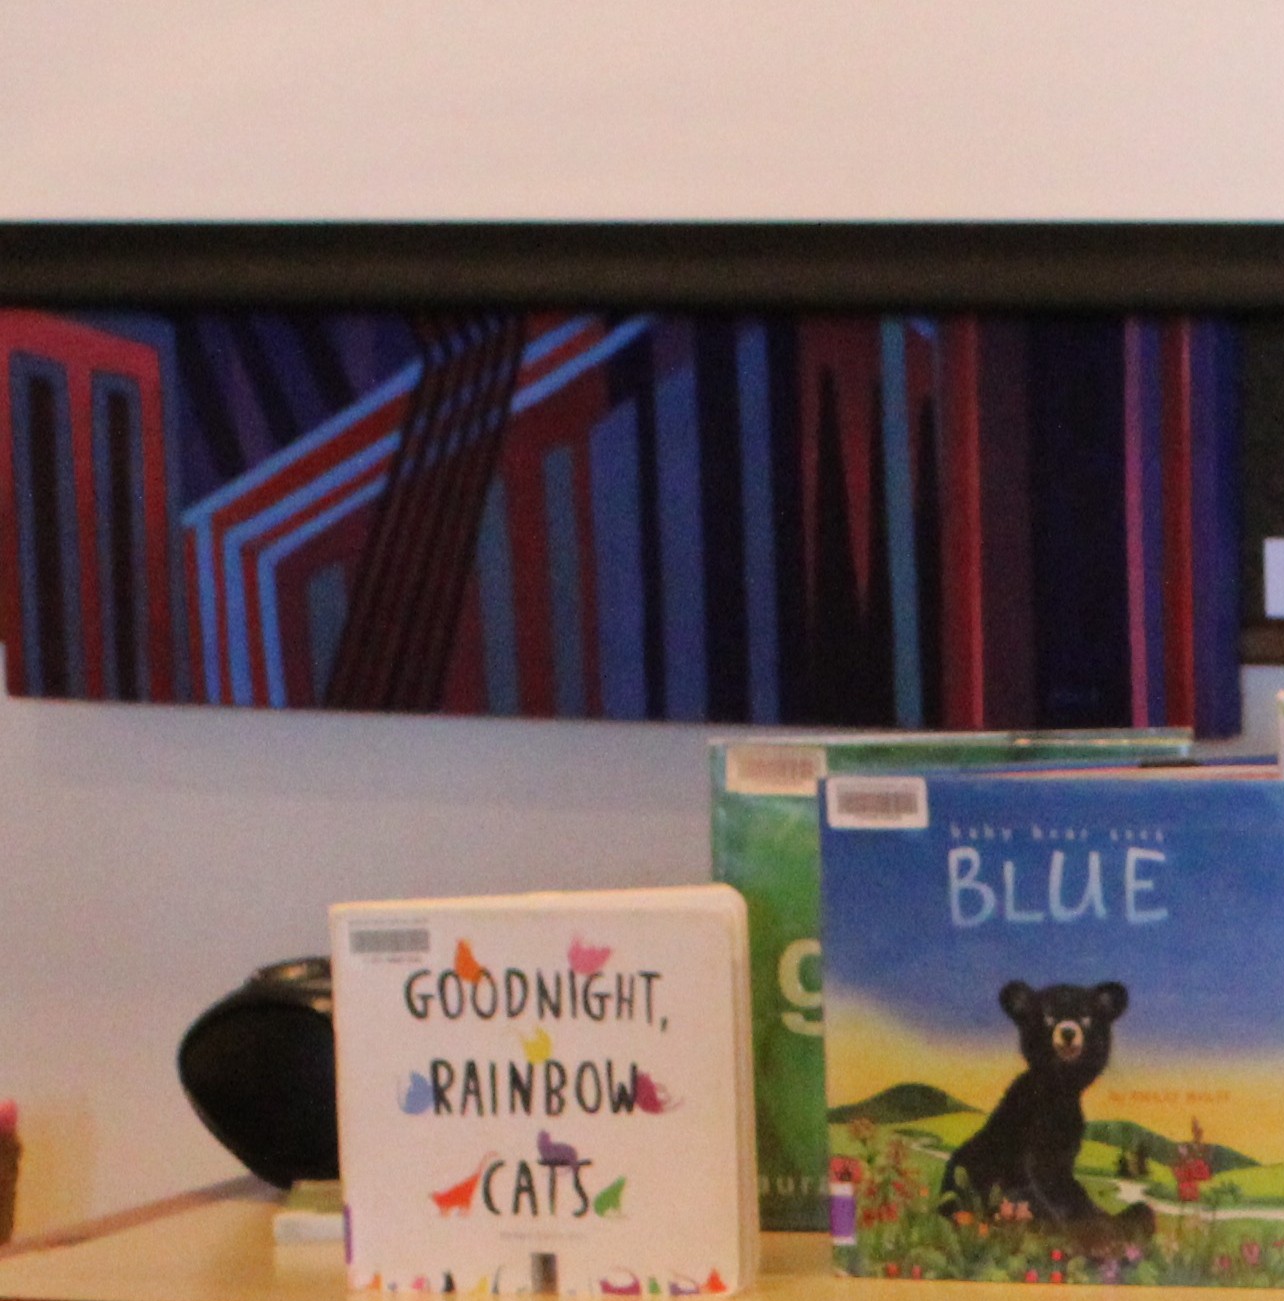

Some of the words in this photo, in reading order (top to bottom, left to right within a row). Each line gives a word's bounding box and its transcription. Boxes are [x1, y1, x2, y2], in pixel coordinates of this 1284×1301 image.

[948, 845, 1169, 927] BLUE
[404, 967, 668, 1032] GOODNIGHT,
[430, 1058, 637, 1117] RAINBOW
[482, 1158, 591, 1217] CATS
